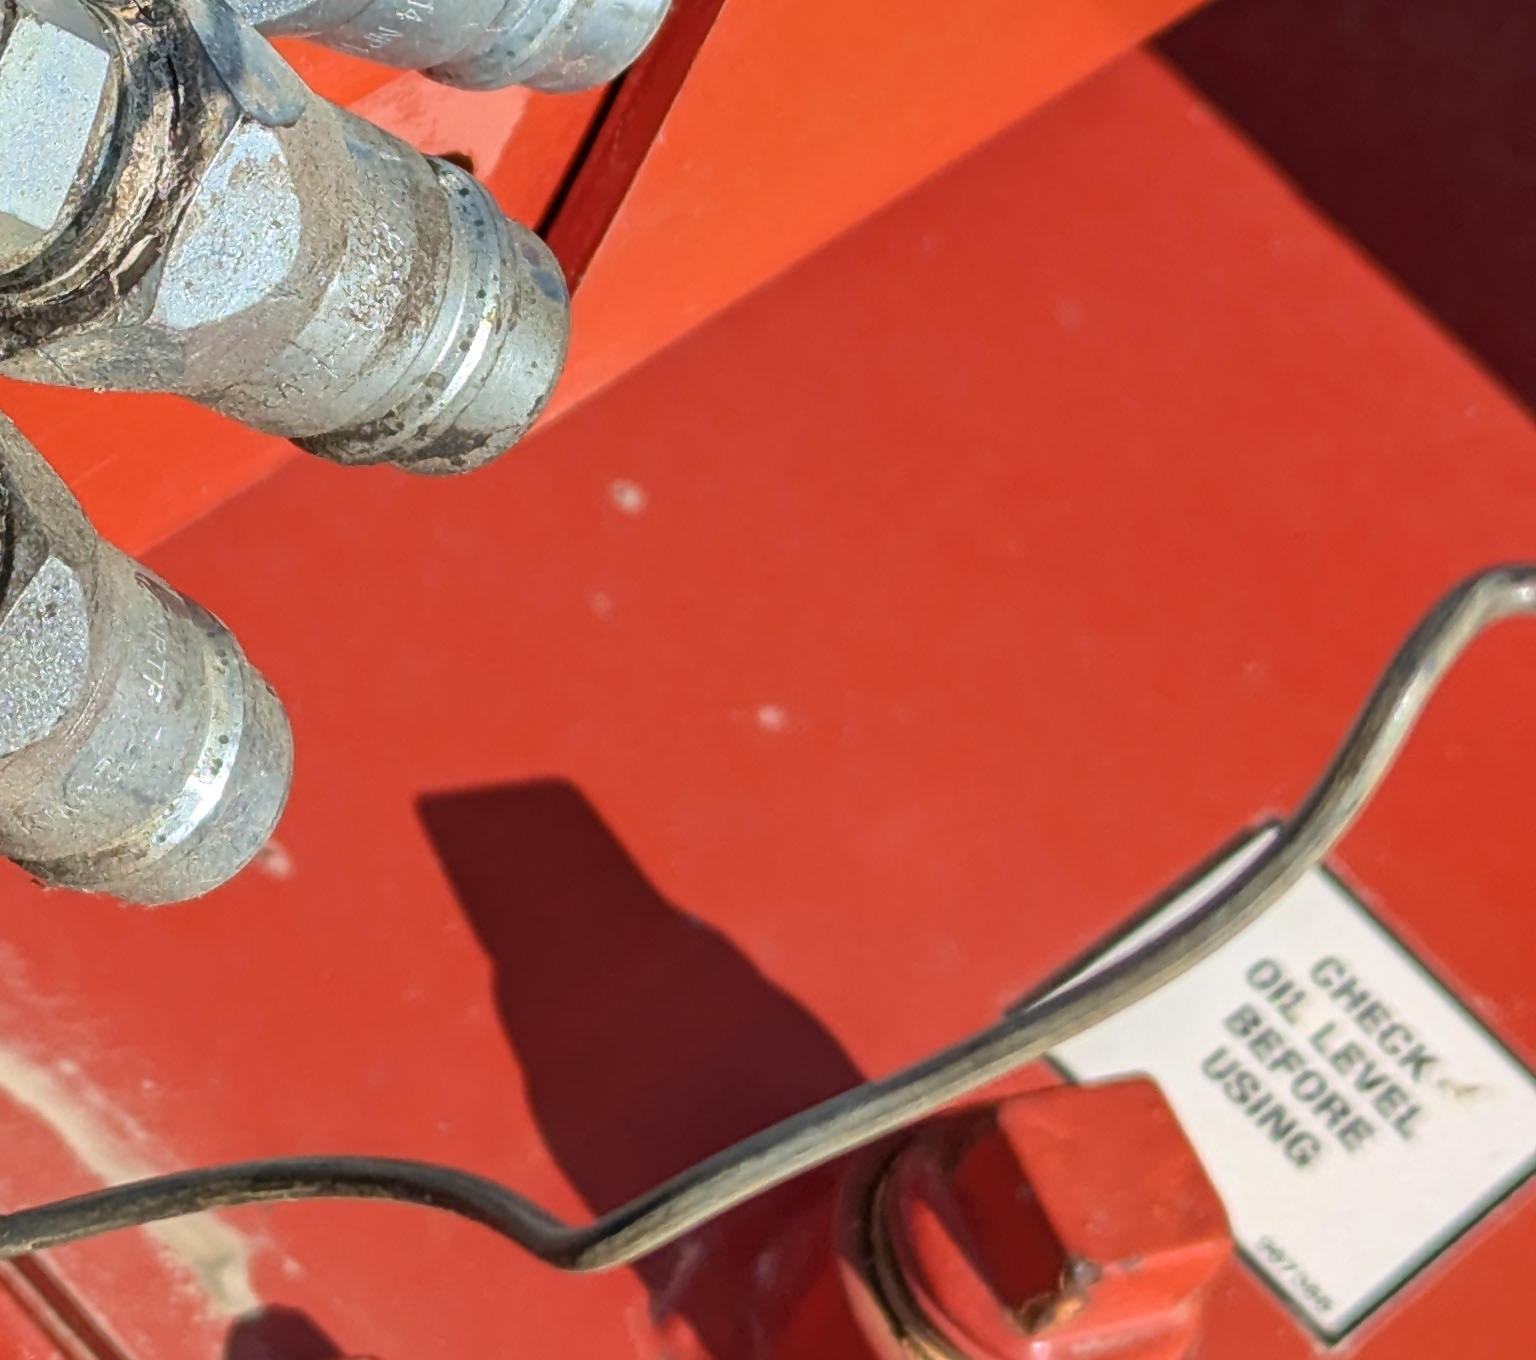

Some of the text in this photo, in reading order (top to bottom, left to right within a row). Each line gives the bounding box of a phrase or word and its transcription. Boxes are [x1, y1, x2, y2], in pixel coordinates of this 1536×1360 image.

[1224, 1003, 1375, 1152] BEFORE
[1245, 957, 1422, 1141] OIL LEVEL
[1309, 955, 1440, 1083] CHECK
[1201, 1046, 1322, 1168] USING
